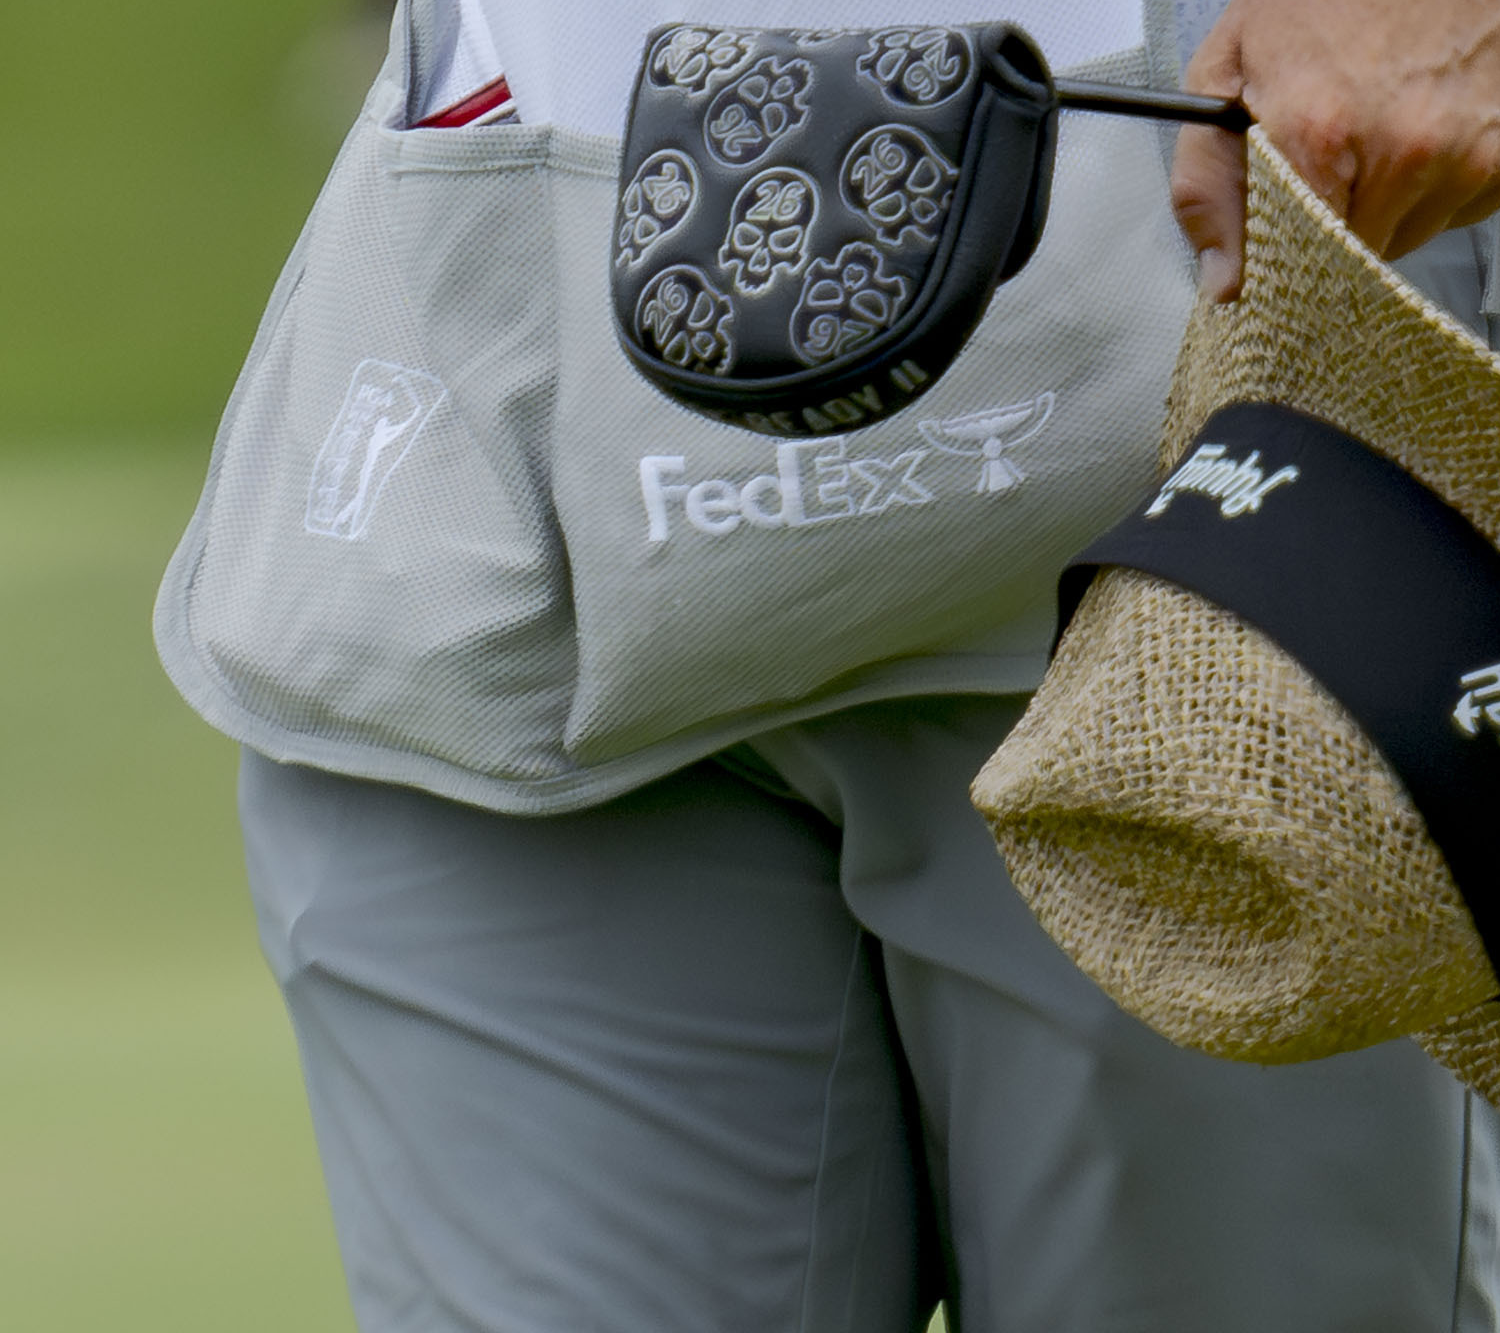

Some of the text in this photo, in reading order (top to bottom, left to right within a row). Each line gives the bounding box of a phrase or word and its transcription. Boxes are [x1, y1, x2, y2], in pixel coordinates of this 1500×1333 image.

[849, 133, 907, 200] 26
[744, 180, 806, 221] 26
[638, 435, 938, 543] FedEx
